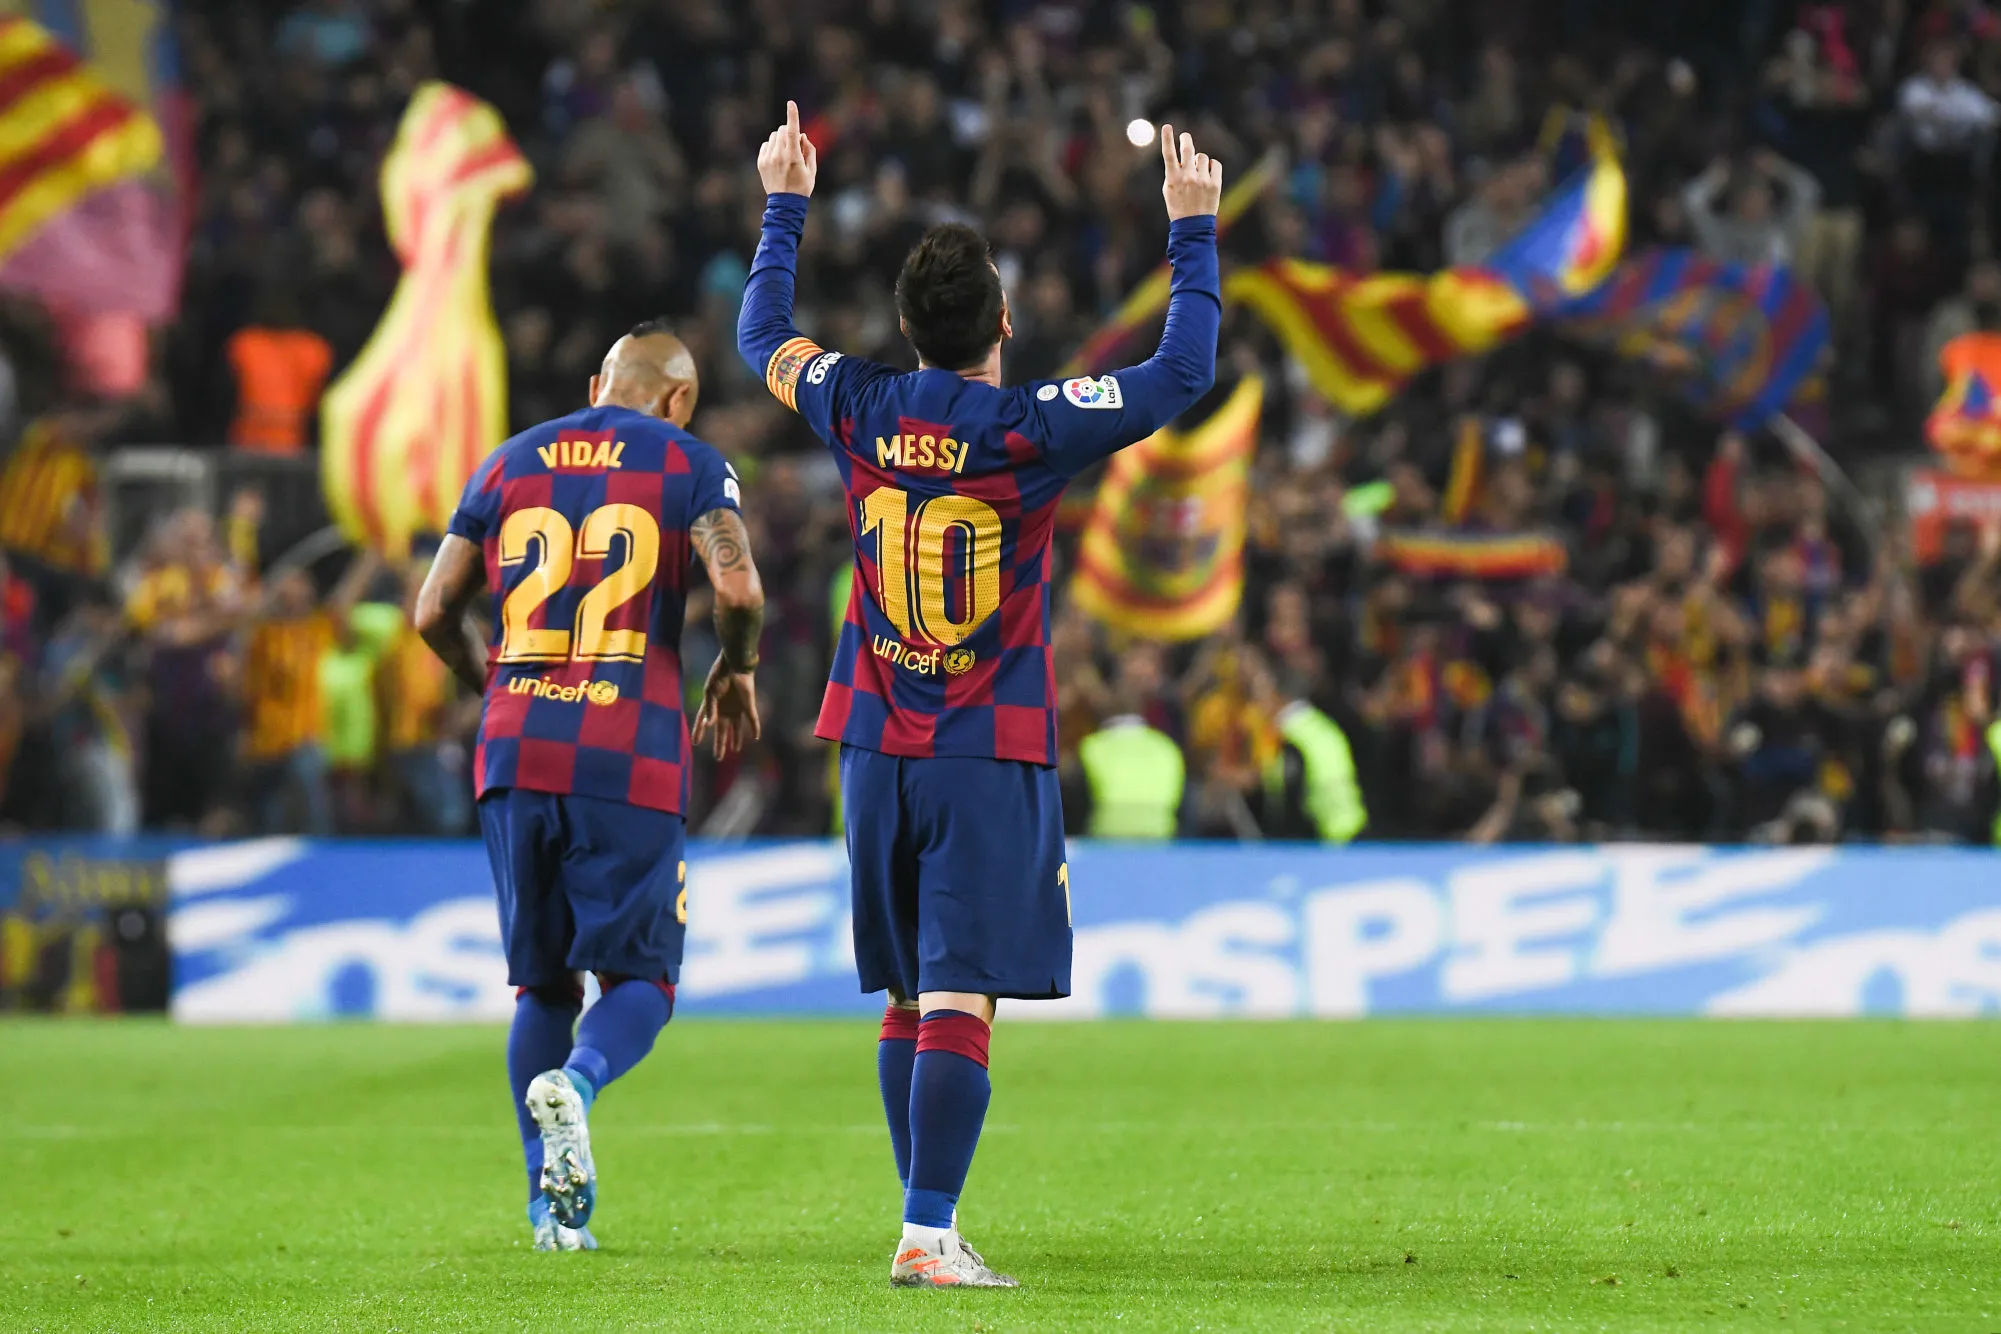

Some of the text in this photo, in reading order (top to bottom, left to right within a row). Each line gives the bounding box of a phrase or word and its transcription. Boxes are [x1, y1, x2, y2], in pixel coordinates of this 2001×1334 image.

[536, 440, 626, 469] VIDAL
[875, 433, 970, 474] MESSI
[497, 503, 661, 664] 22
[859, 486, 1003, 646] 10
[872, 633, 941, 676] unicef
[508, 676, 590, 703] unicef
